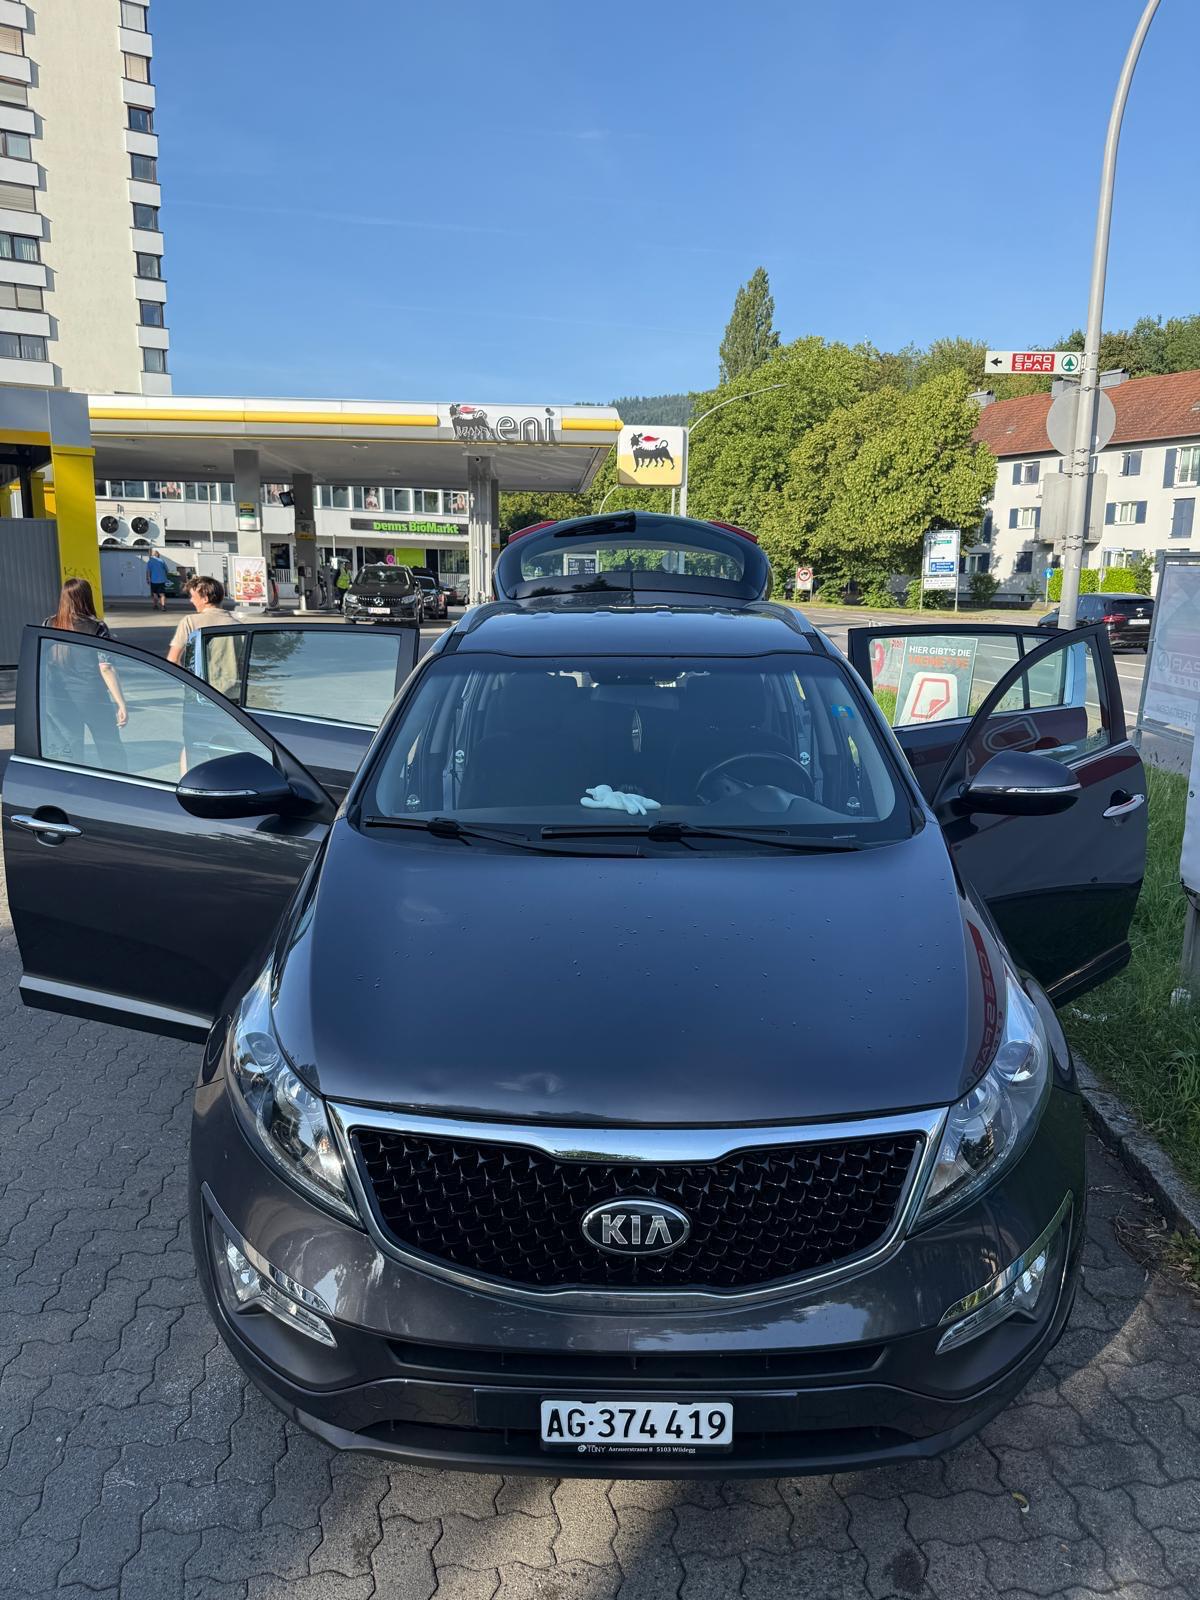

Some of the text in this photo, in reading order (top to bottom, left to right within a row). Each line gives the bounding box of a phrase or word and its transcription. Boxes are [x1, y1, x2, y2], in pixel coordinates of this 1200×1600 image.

[1015, 354, 1052, 363] EURO
[1014, 363, 1051, 371] SPAR
[496, 407, 552, 441] eni
[909, 645, 929, 655] HIER
[957, 648, 972, 658] DIE
[600, 1214, 673, 1245] KIA
[672, 1446, 696, 1454] Wildegg
